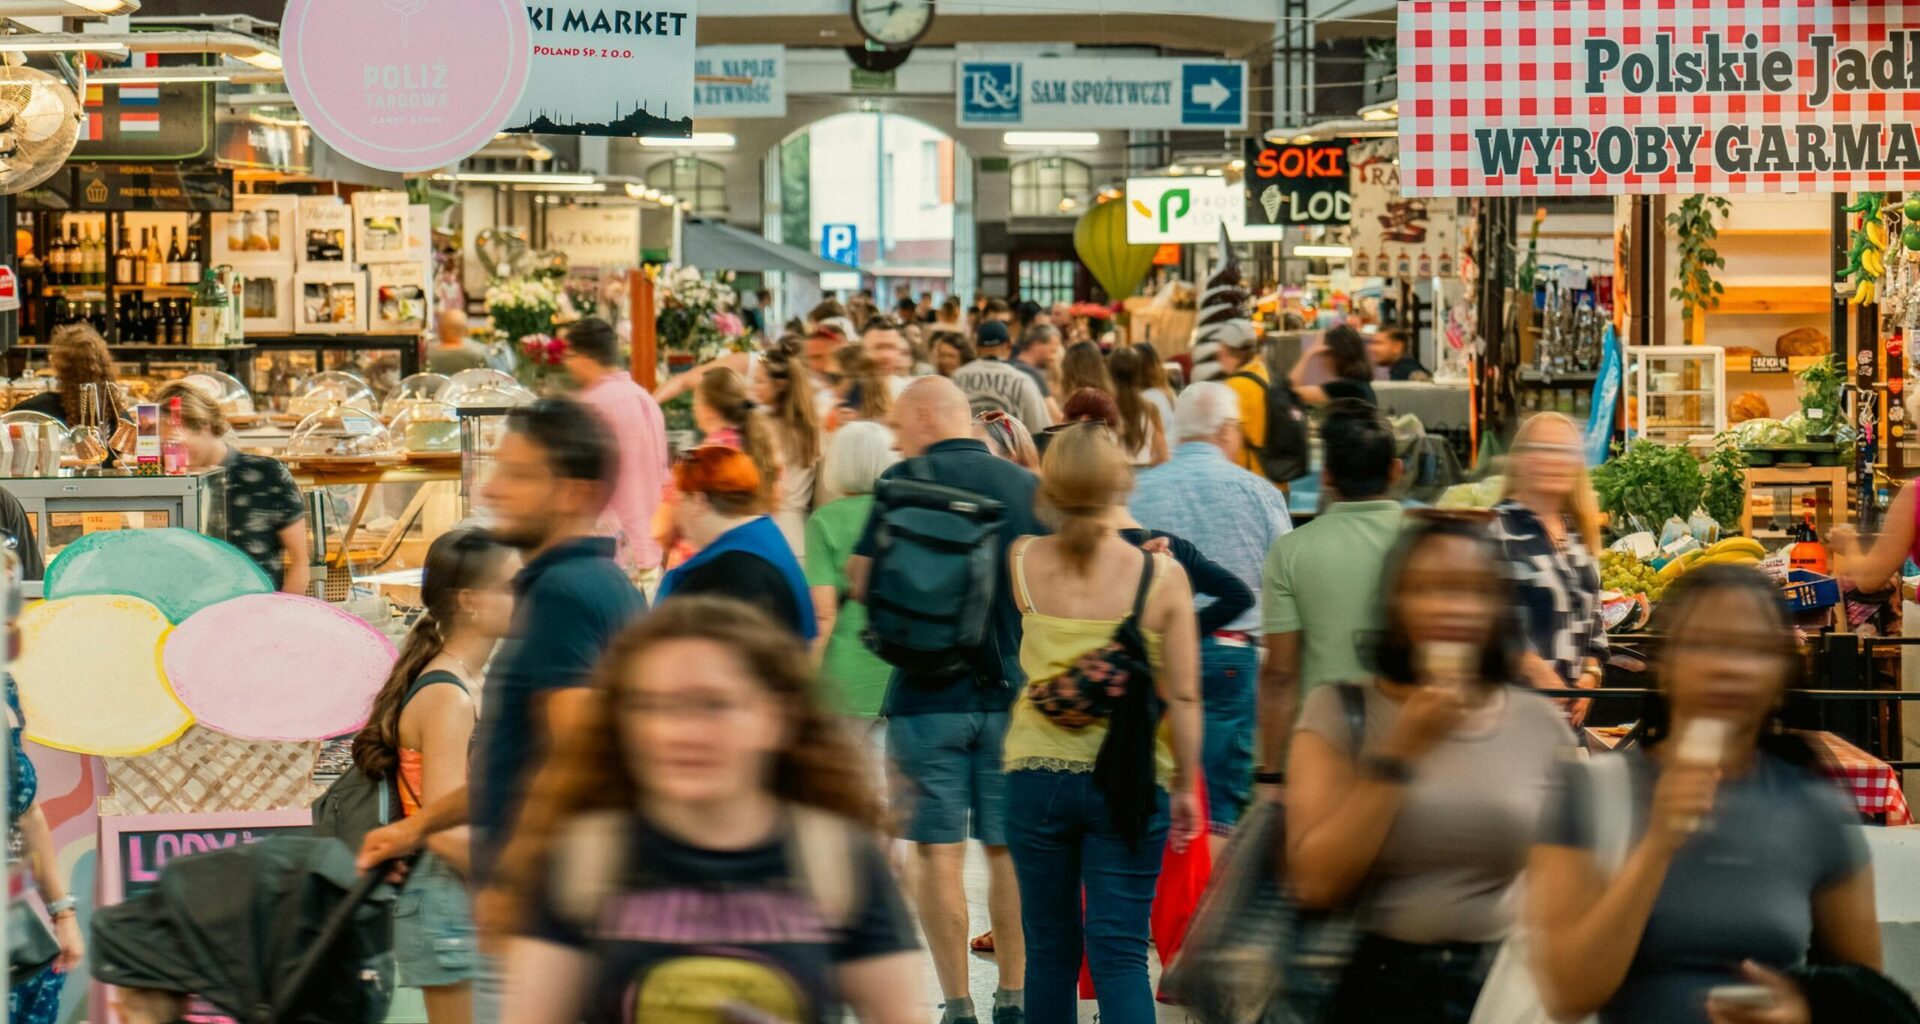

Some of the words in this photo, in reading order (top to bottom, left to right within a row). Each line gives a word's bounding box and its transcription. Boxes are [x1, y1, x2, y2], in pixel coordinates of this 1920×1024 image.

[562, 8, 688, 37] MARKET
[533, 44, 580, 57] POLAND
[1584, 33, 1793, 93] Polskie
[364, 57, 449, 90] POLIŻ
[364, 93, 449, 109] TARGOWA
[1031, 80, 1066, 104] SAM
[1071, 75, 1173, 105] SPOŻYWCZY
[1256, 147, 1343, 178] SOKI
[1474, 125, 1703, 177] WYROBY
[1714, 122, 1920, 175] GARMA
[1290, 190, 1352, 221] LOD
[828, 226, 852, 258] P
